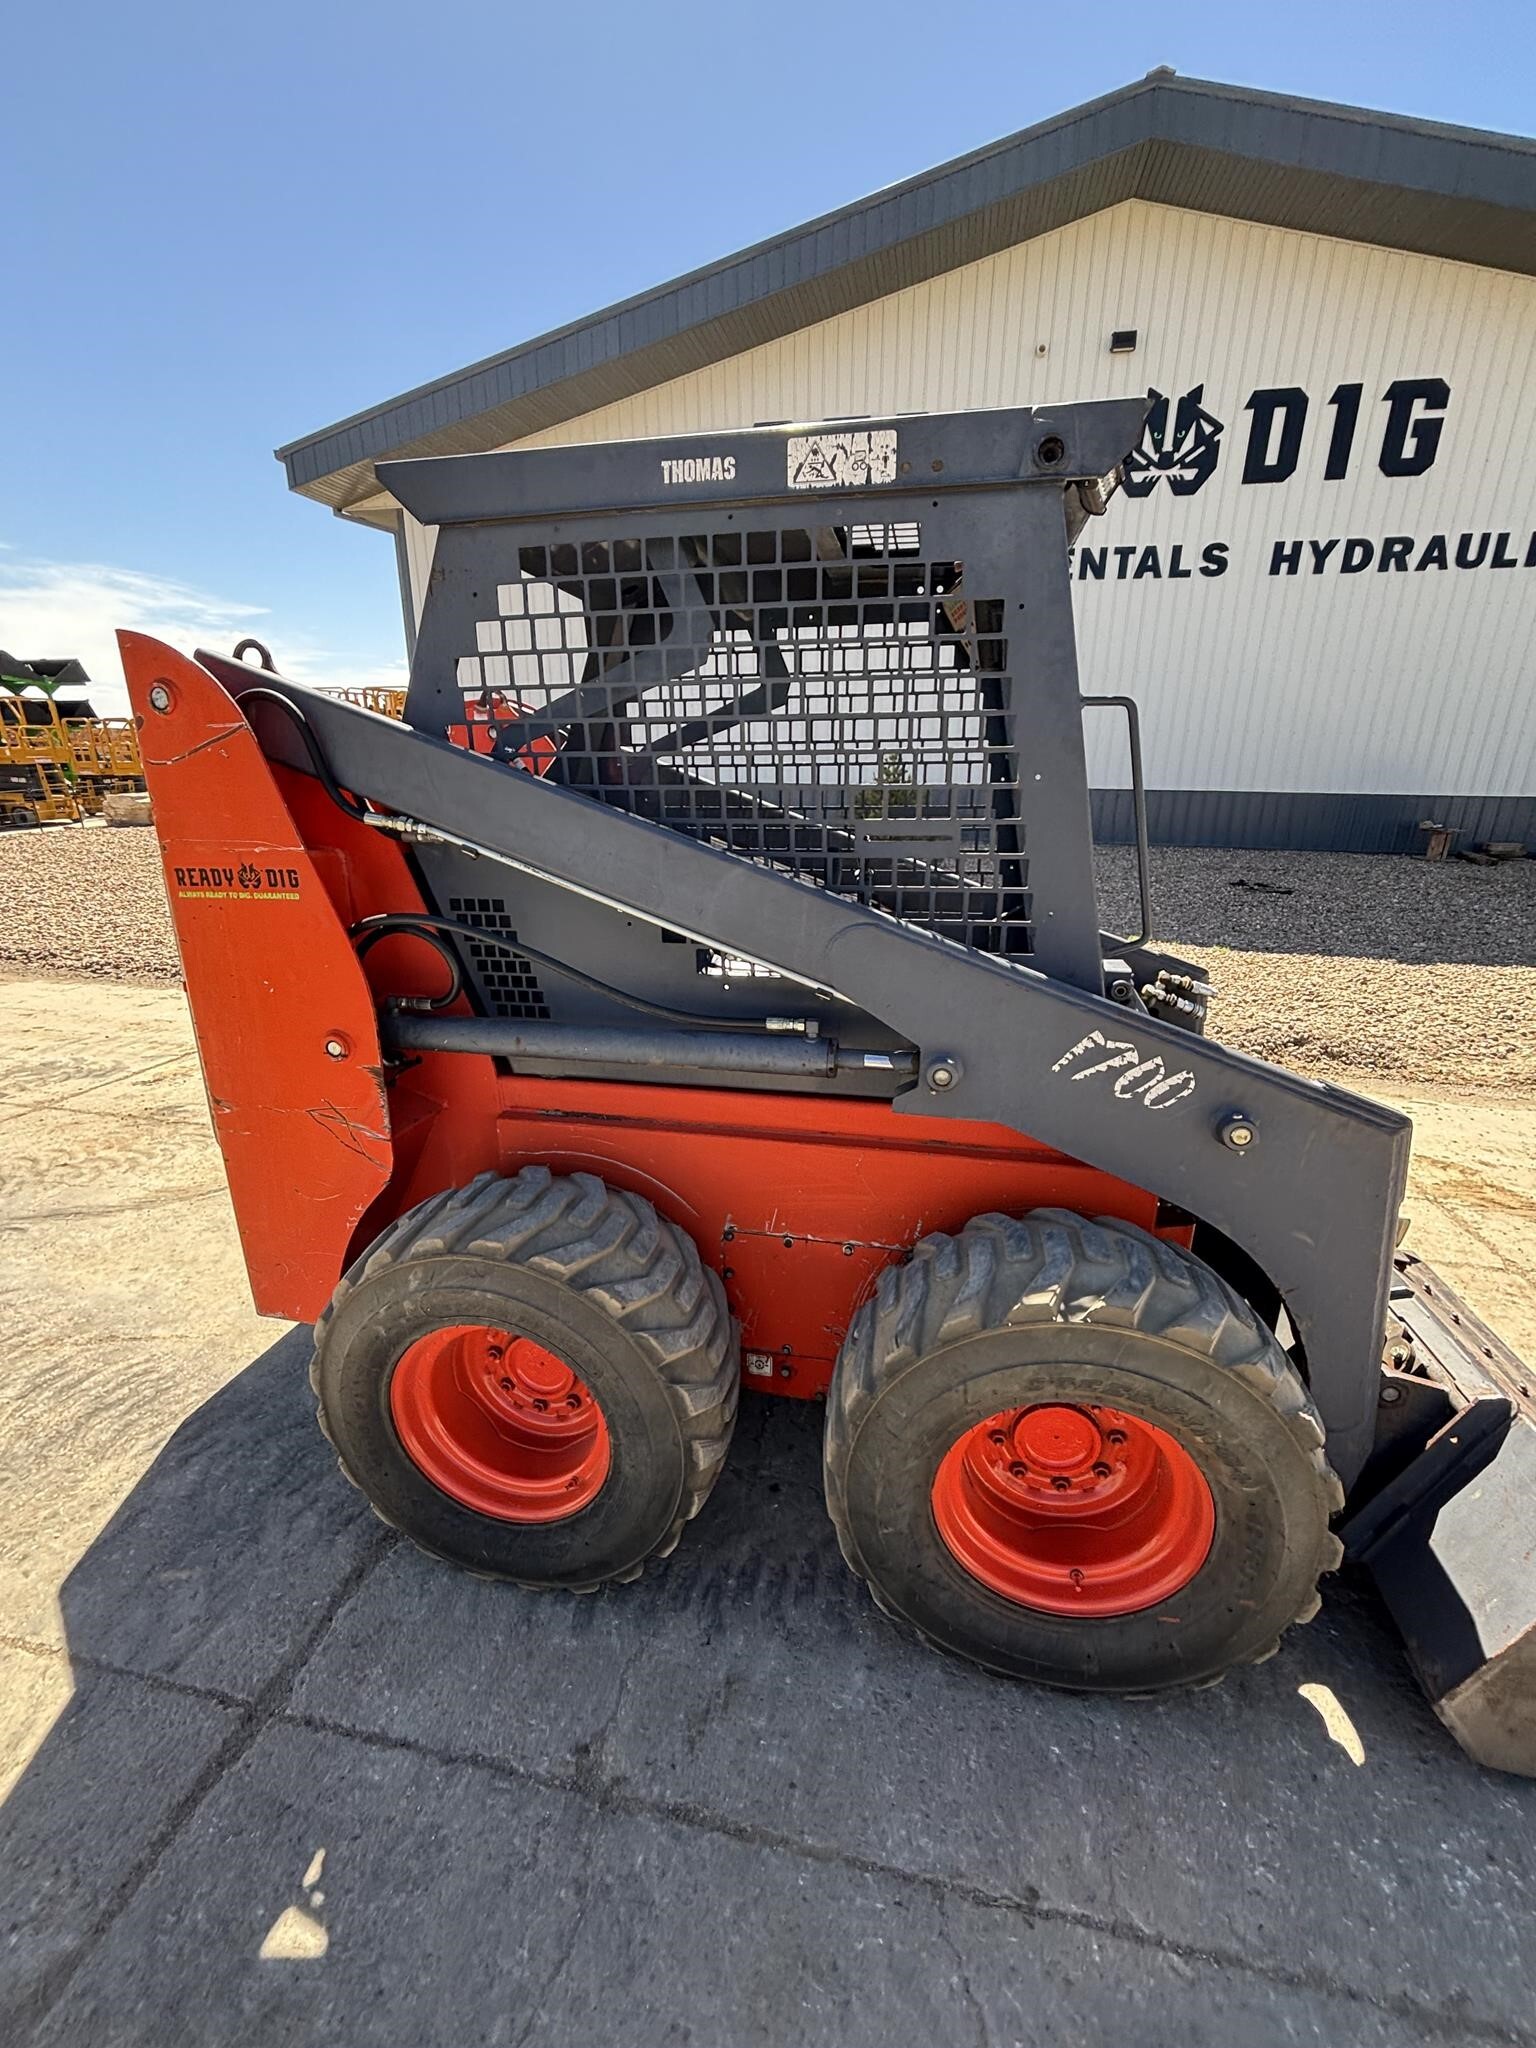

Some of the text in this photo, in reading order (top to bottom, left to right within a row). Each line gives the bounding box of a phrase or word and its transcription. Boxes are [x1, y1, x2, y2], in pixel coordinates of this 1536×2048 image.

[661, 456, 736, 485] THOMAS
[174, 867, 299, 888] READY DIG
[229, 891, 238, 899] TO
[253, 892, 300, 900] GUARANTEED
